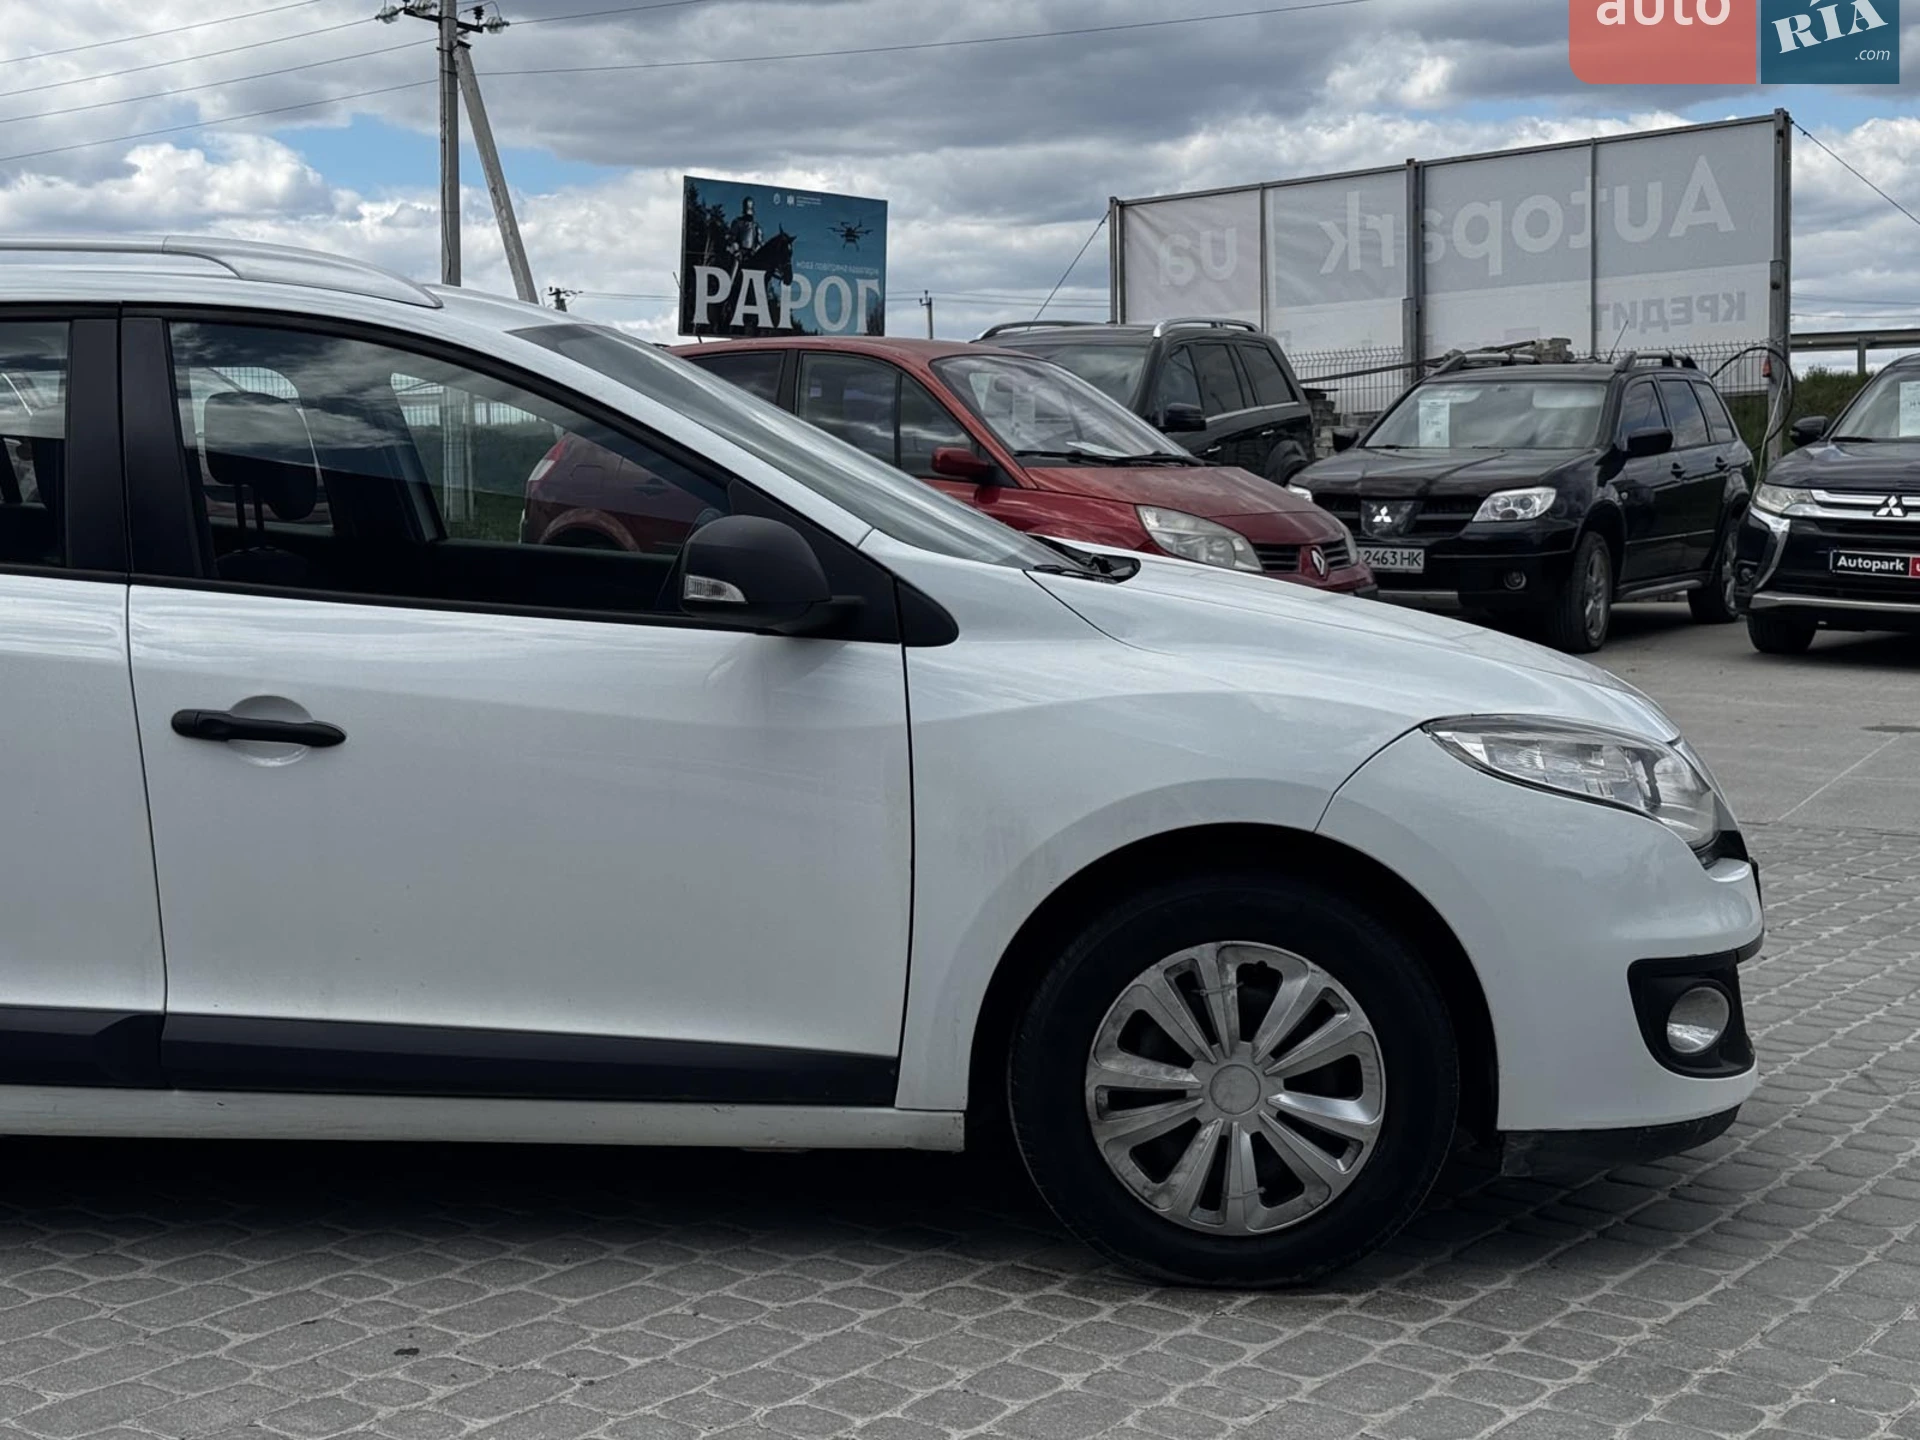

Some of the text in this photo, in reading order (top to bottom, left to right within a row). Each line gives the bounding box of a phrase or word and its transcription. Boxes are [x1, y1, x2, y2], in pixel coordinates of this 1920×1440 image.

[692, 265, 881, 333] РАРОГ
[1363, 550, 1398, 565] 2463
[1837, 556, 1905, 572] Autopark
